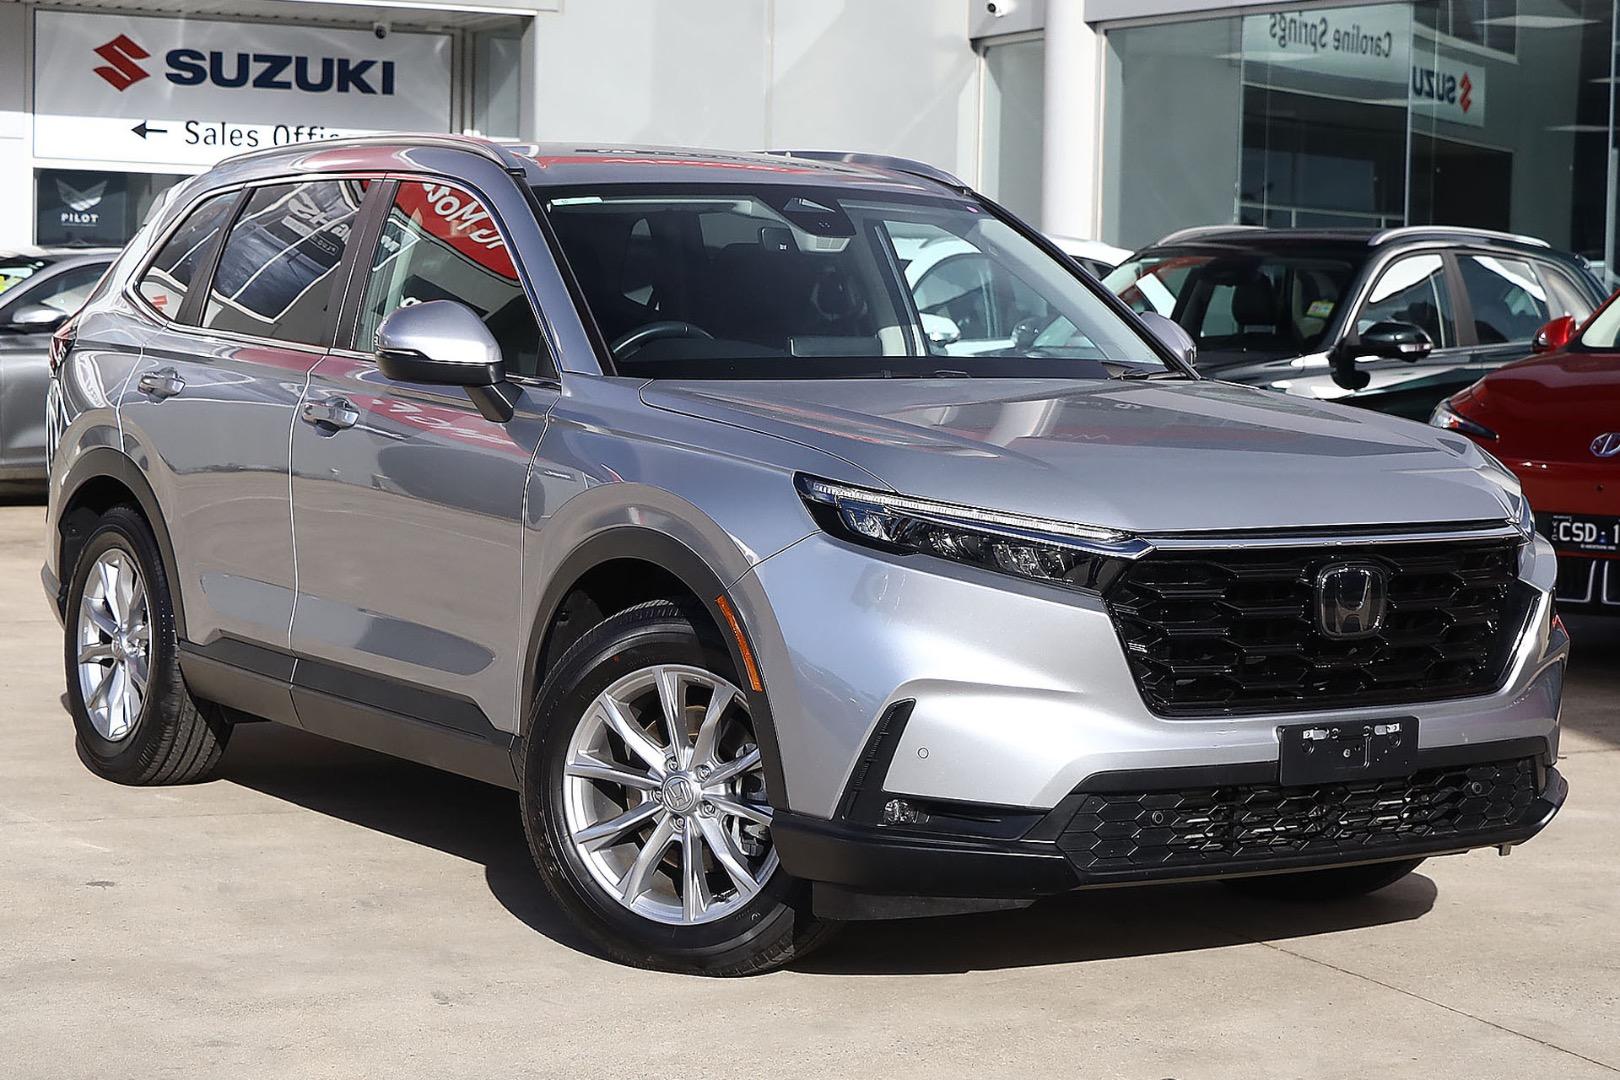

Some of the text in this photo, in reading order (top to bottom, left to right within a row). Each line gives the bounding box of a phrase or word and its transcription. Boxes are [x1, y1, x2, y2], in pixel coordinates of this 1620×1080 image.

[165, 49, 396, 96] SUZUKI
[185, 120, 259, 148] Sales
[60, 212, 100, 223] PILOT
